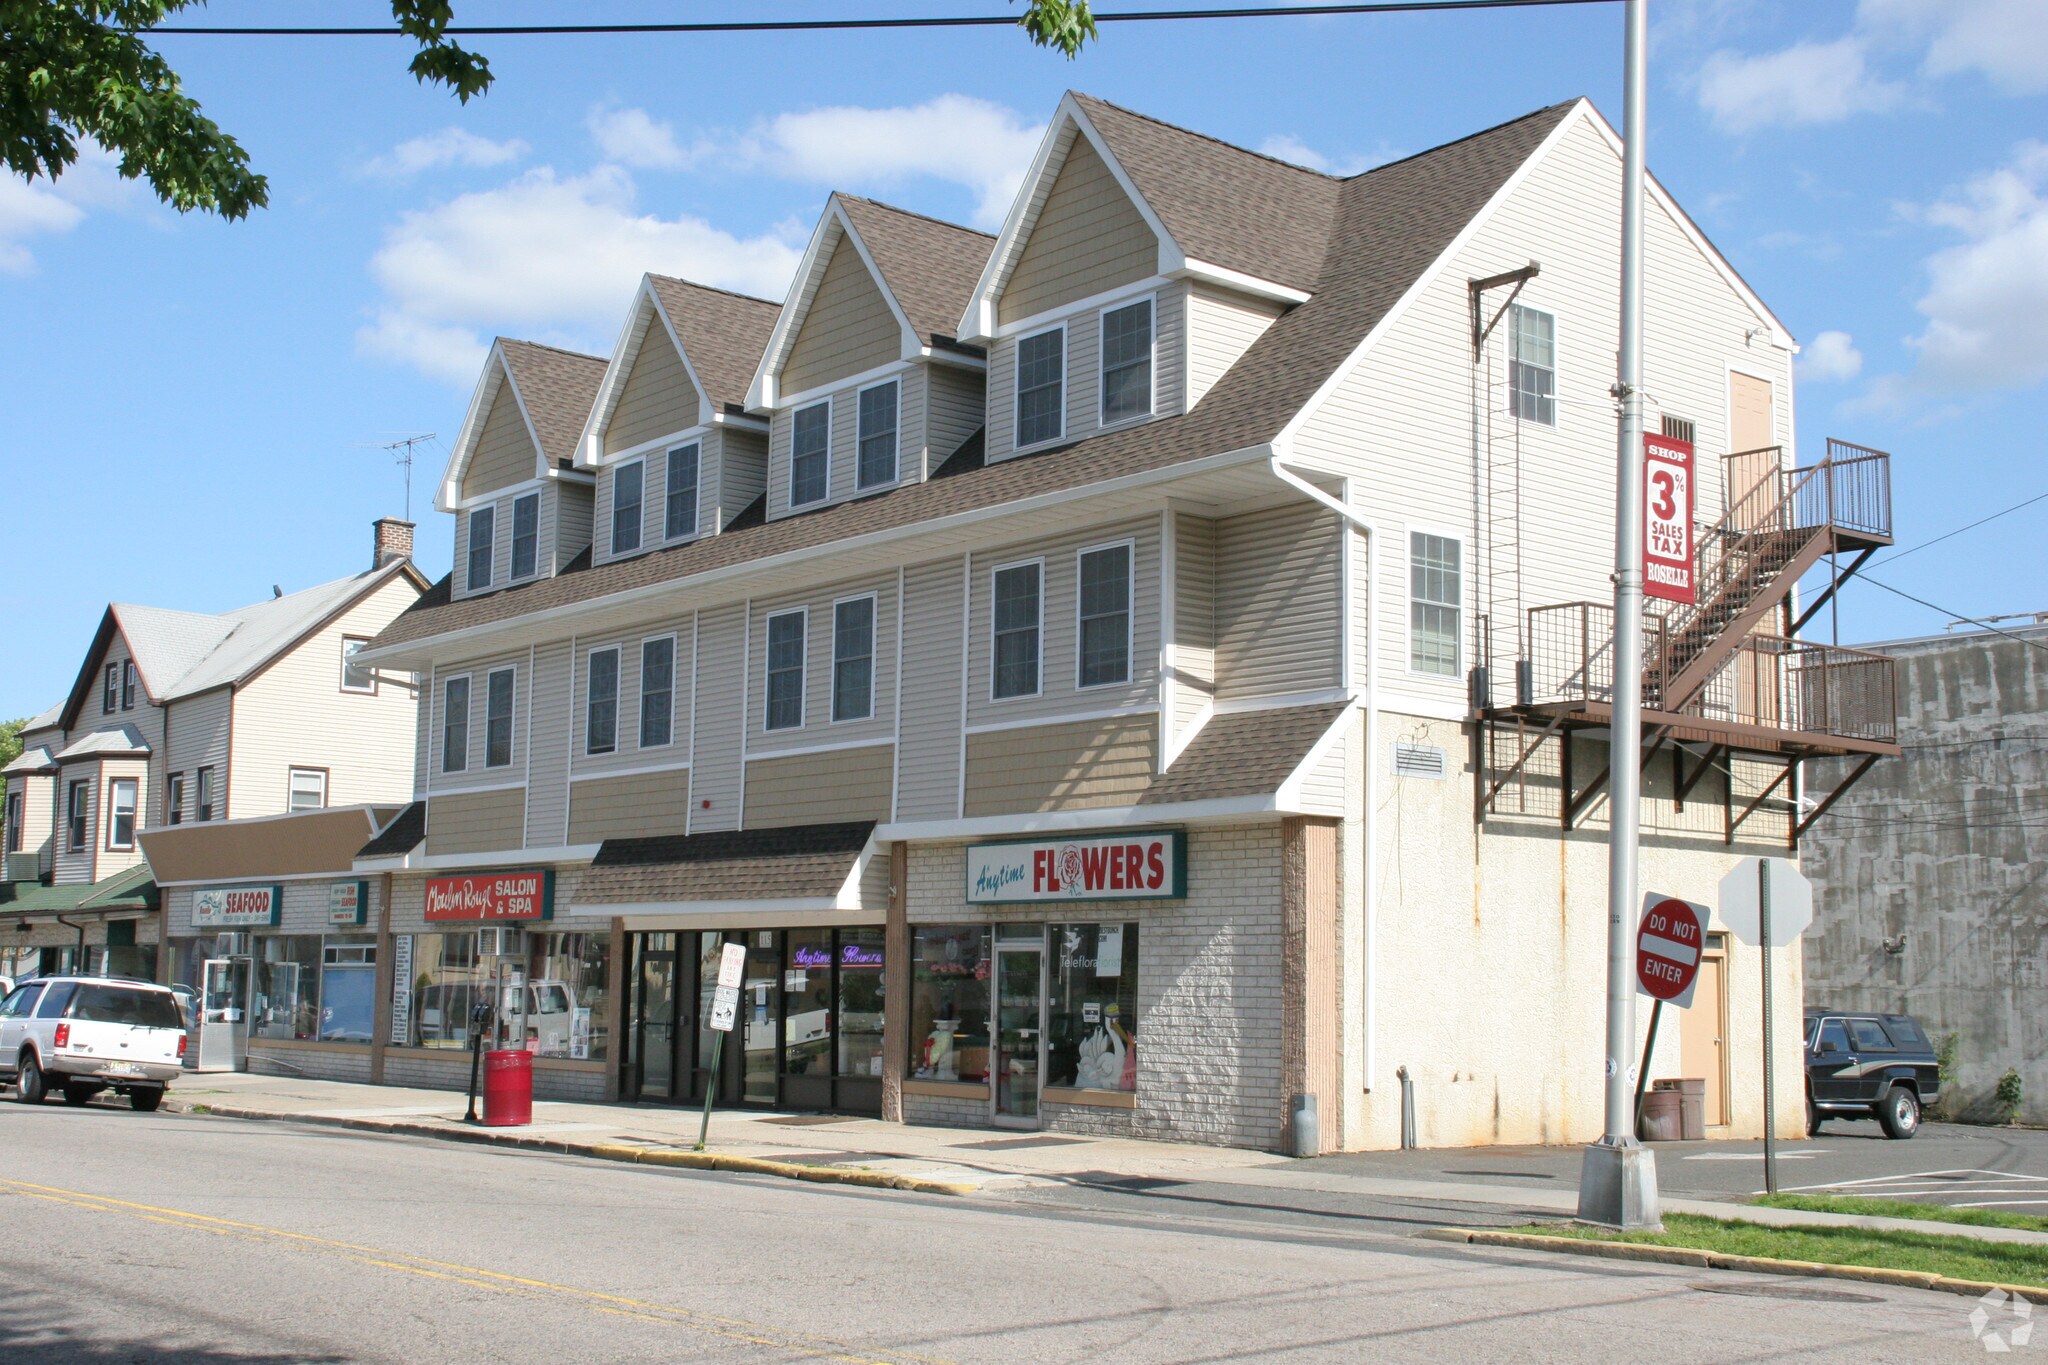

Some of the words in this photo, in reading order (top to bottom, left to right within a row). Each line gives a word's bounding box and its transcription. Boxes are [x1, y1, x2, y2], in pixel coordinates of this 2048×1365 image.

[1649, 445, 1687, 462] SHOP
[1652, 470, 1685, 521] 3%
[1652, 521, 1683, 540] SALES
[1652, 535, 1682, 556] TAX
[1647, 562, 1689, 588] ROSELLE
[975, 863, 1025, 897] Anytime
[1033, 842, 1165, 893] FLOWERS
[495, 878, 536, 897] SALON
[225, 891, 270, 914] SEAFOOD
[427, 881, 462, 912] Moulin
[463, 879, 493, 919] Rouge
[496, 900, 504, 914] &
[508, 897, 532, 914] SPA
[1650, 914, 1666, 931] DO
[1672, 921, 1696, 940] NOT
[761, 934, 771, 945] 115
[1060, 954, 1097, 968] Teleflora
[1645, 958, 1682, 983] ENTER
